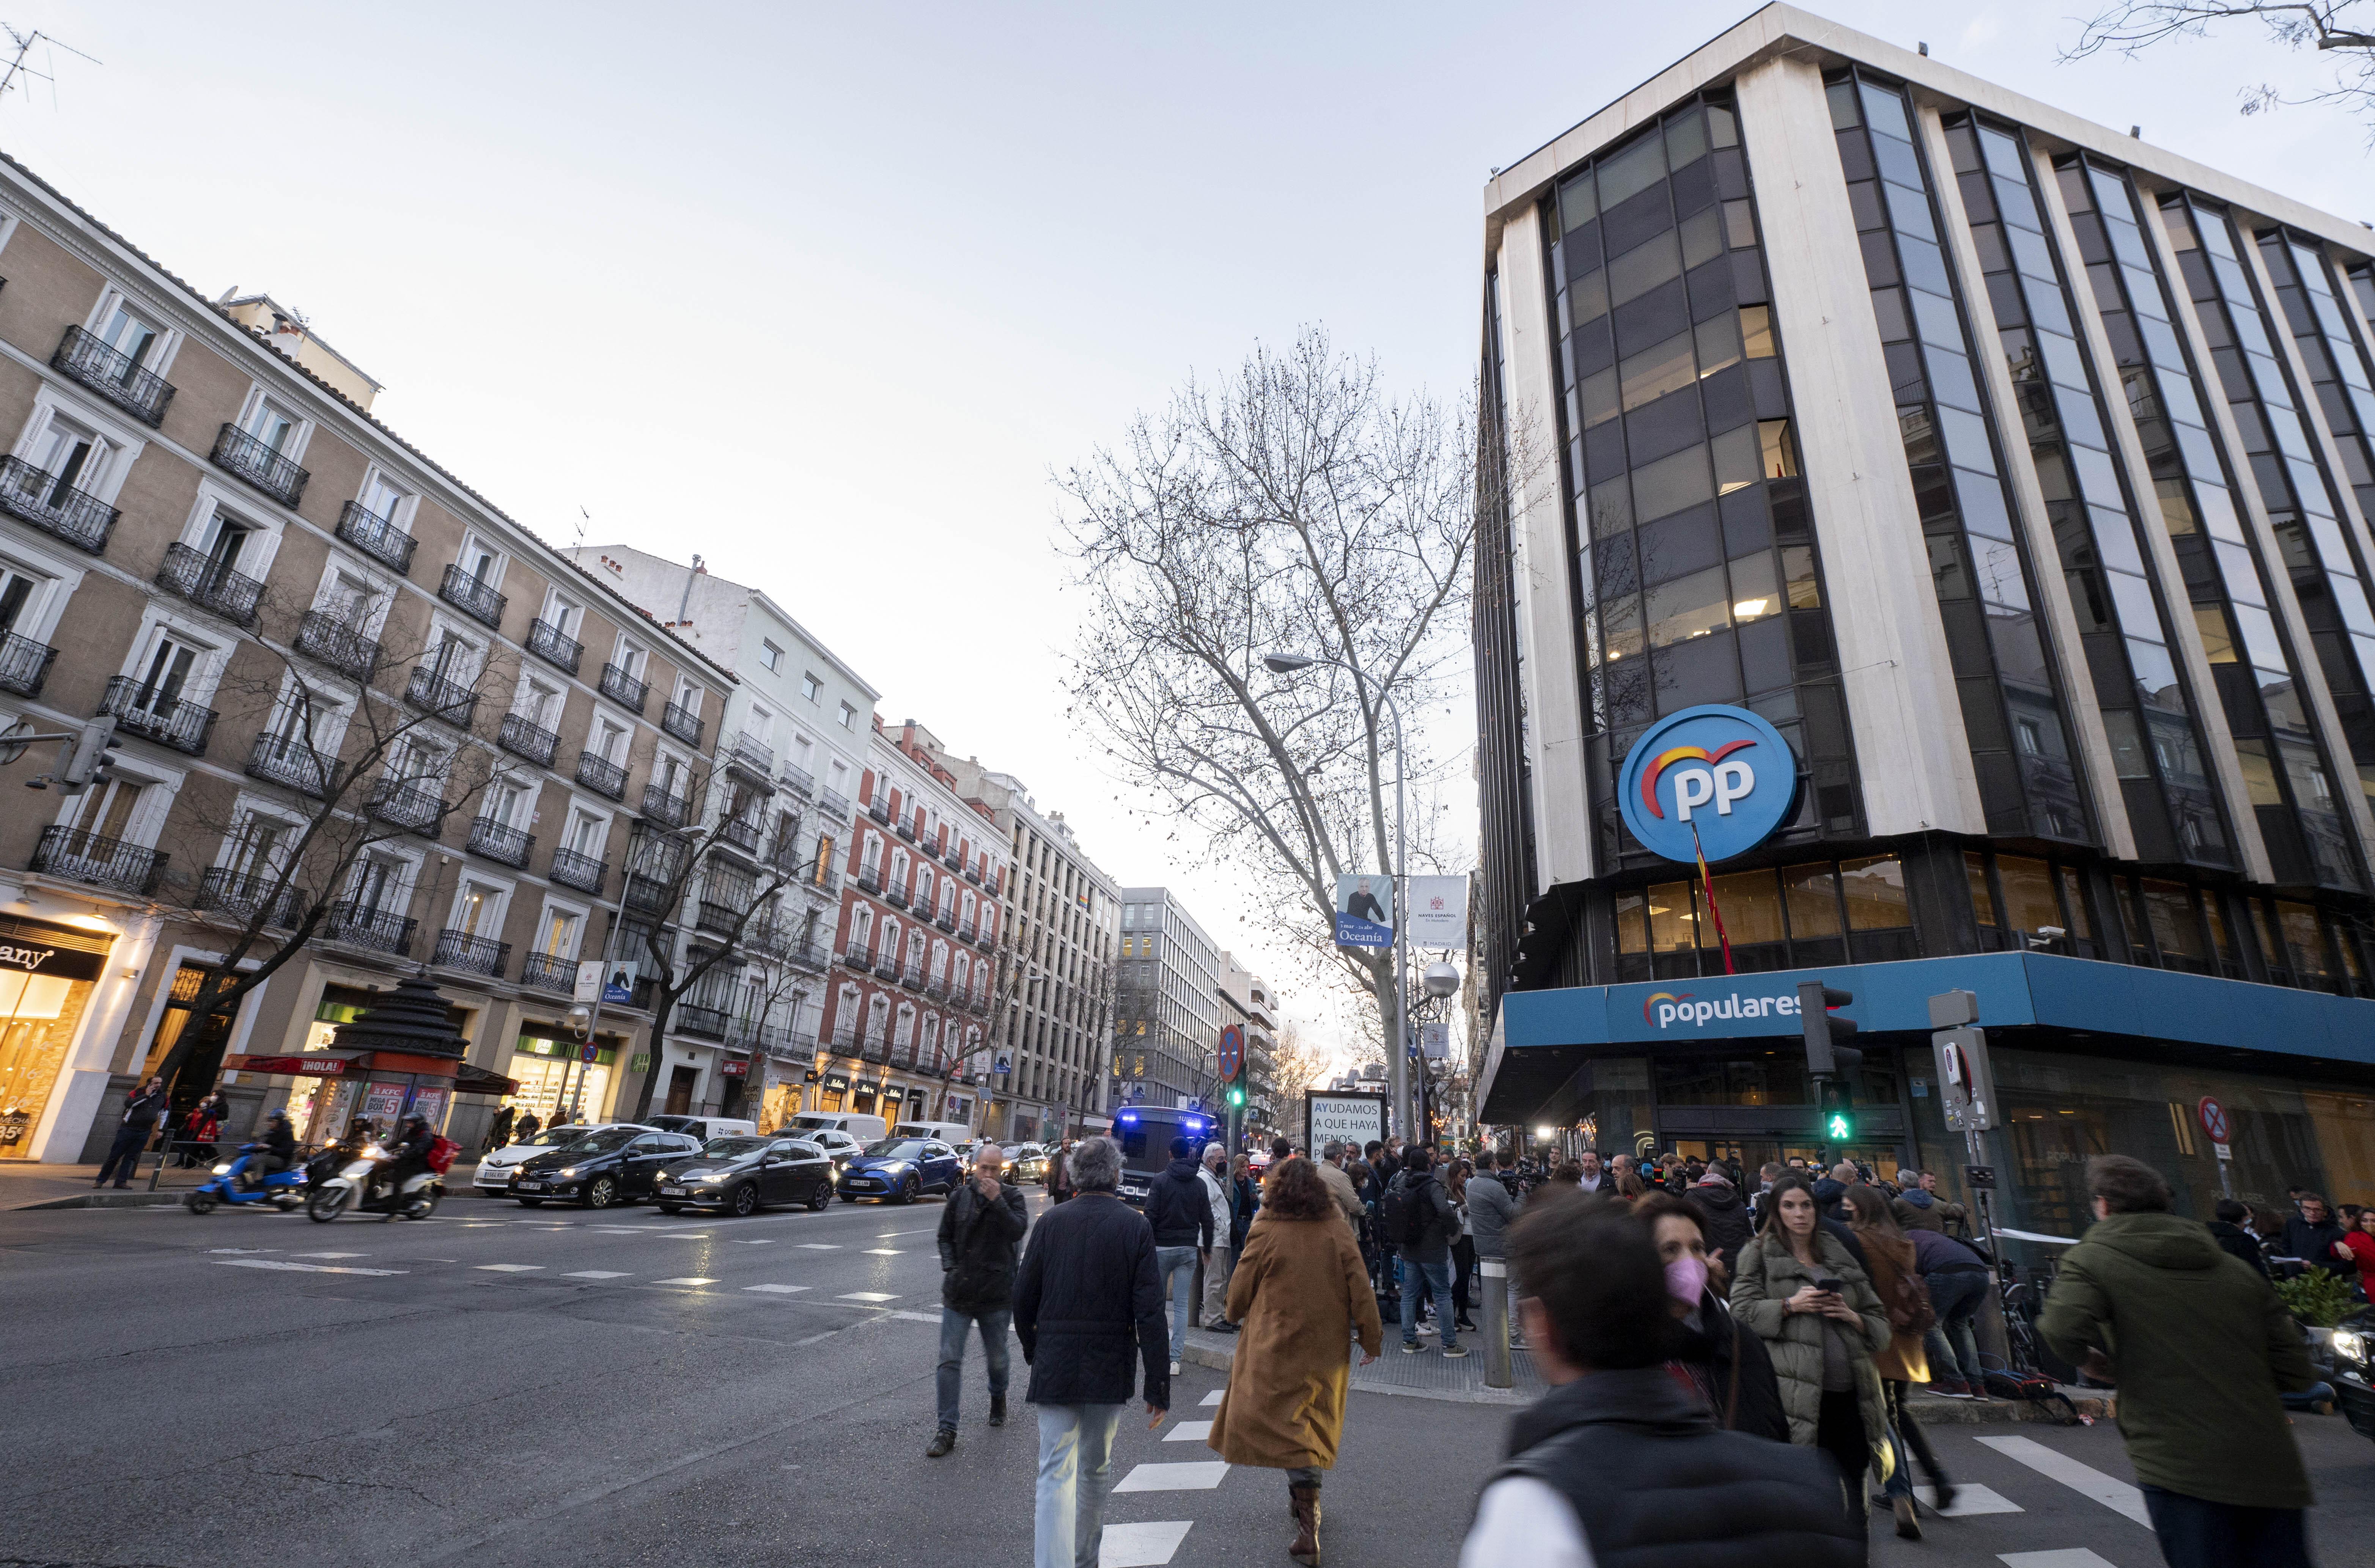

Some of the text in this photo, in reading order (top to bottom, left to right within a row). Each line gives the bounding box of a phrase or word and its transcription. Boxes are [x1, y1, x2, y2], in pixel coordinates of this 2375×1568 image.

[1674, 760, 1755, 822] pp
[1339, 930, 1383, 942] Oceanía
[302, 1062, 338, 1072] ¡HOLA!
[385, 1100, 398, 1113] 5
[1315, 1103, 1377, 1115] AYUDAMOS
[1314, 1119, 1378, 1130] A QUE HAYA
